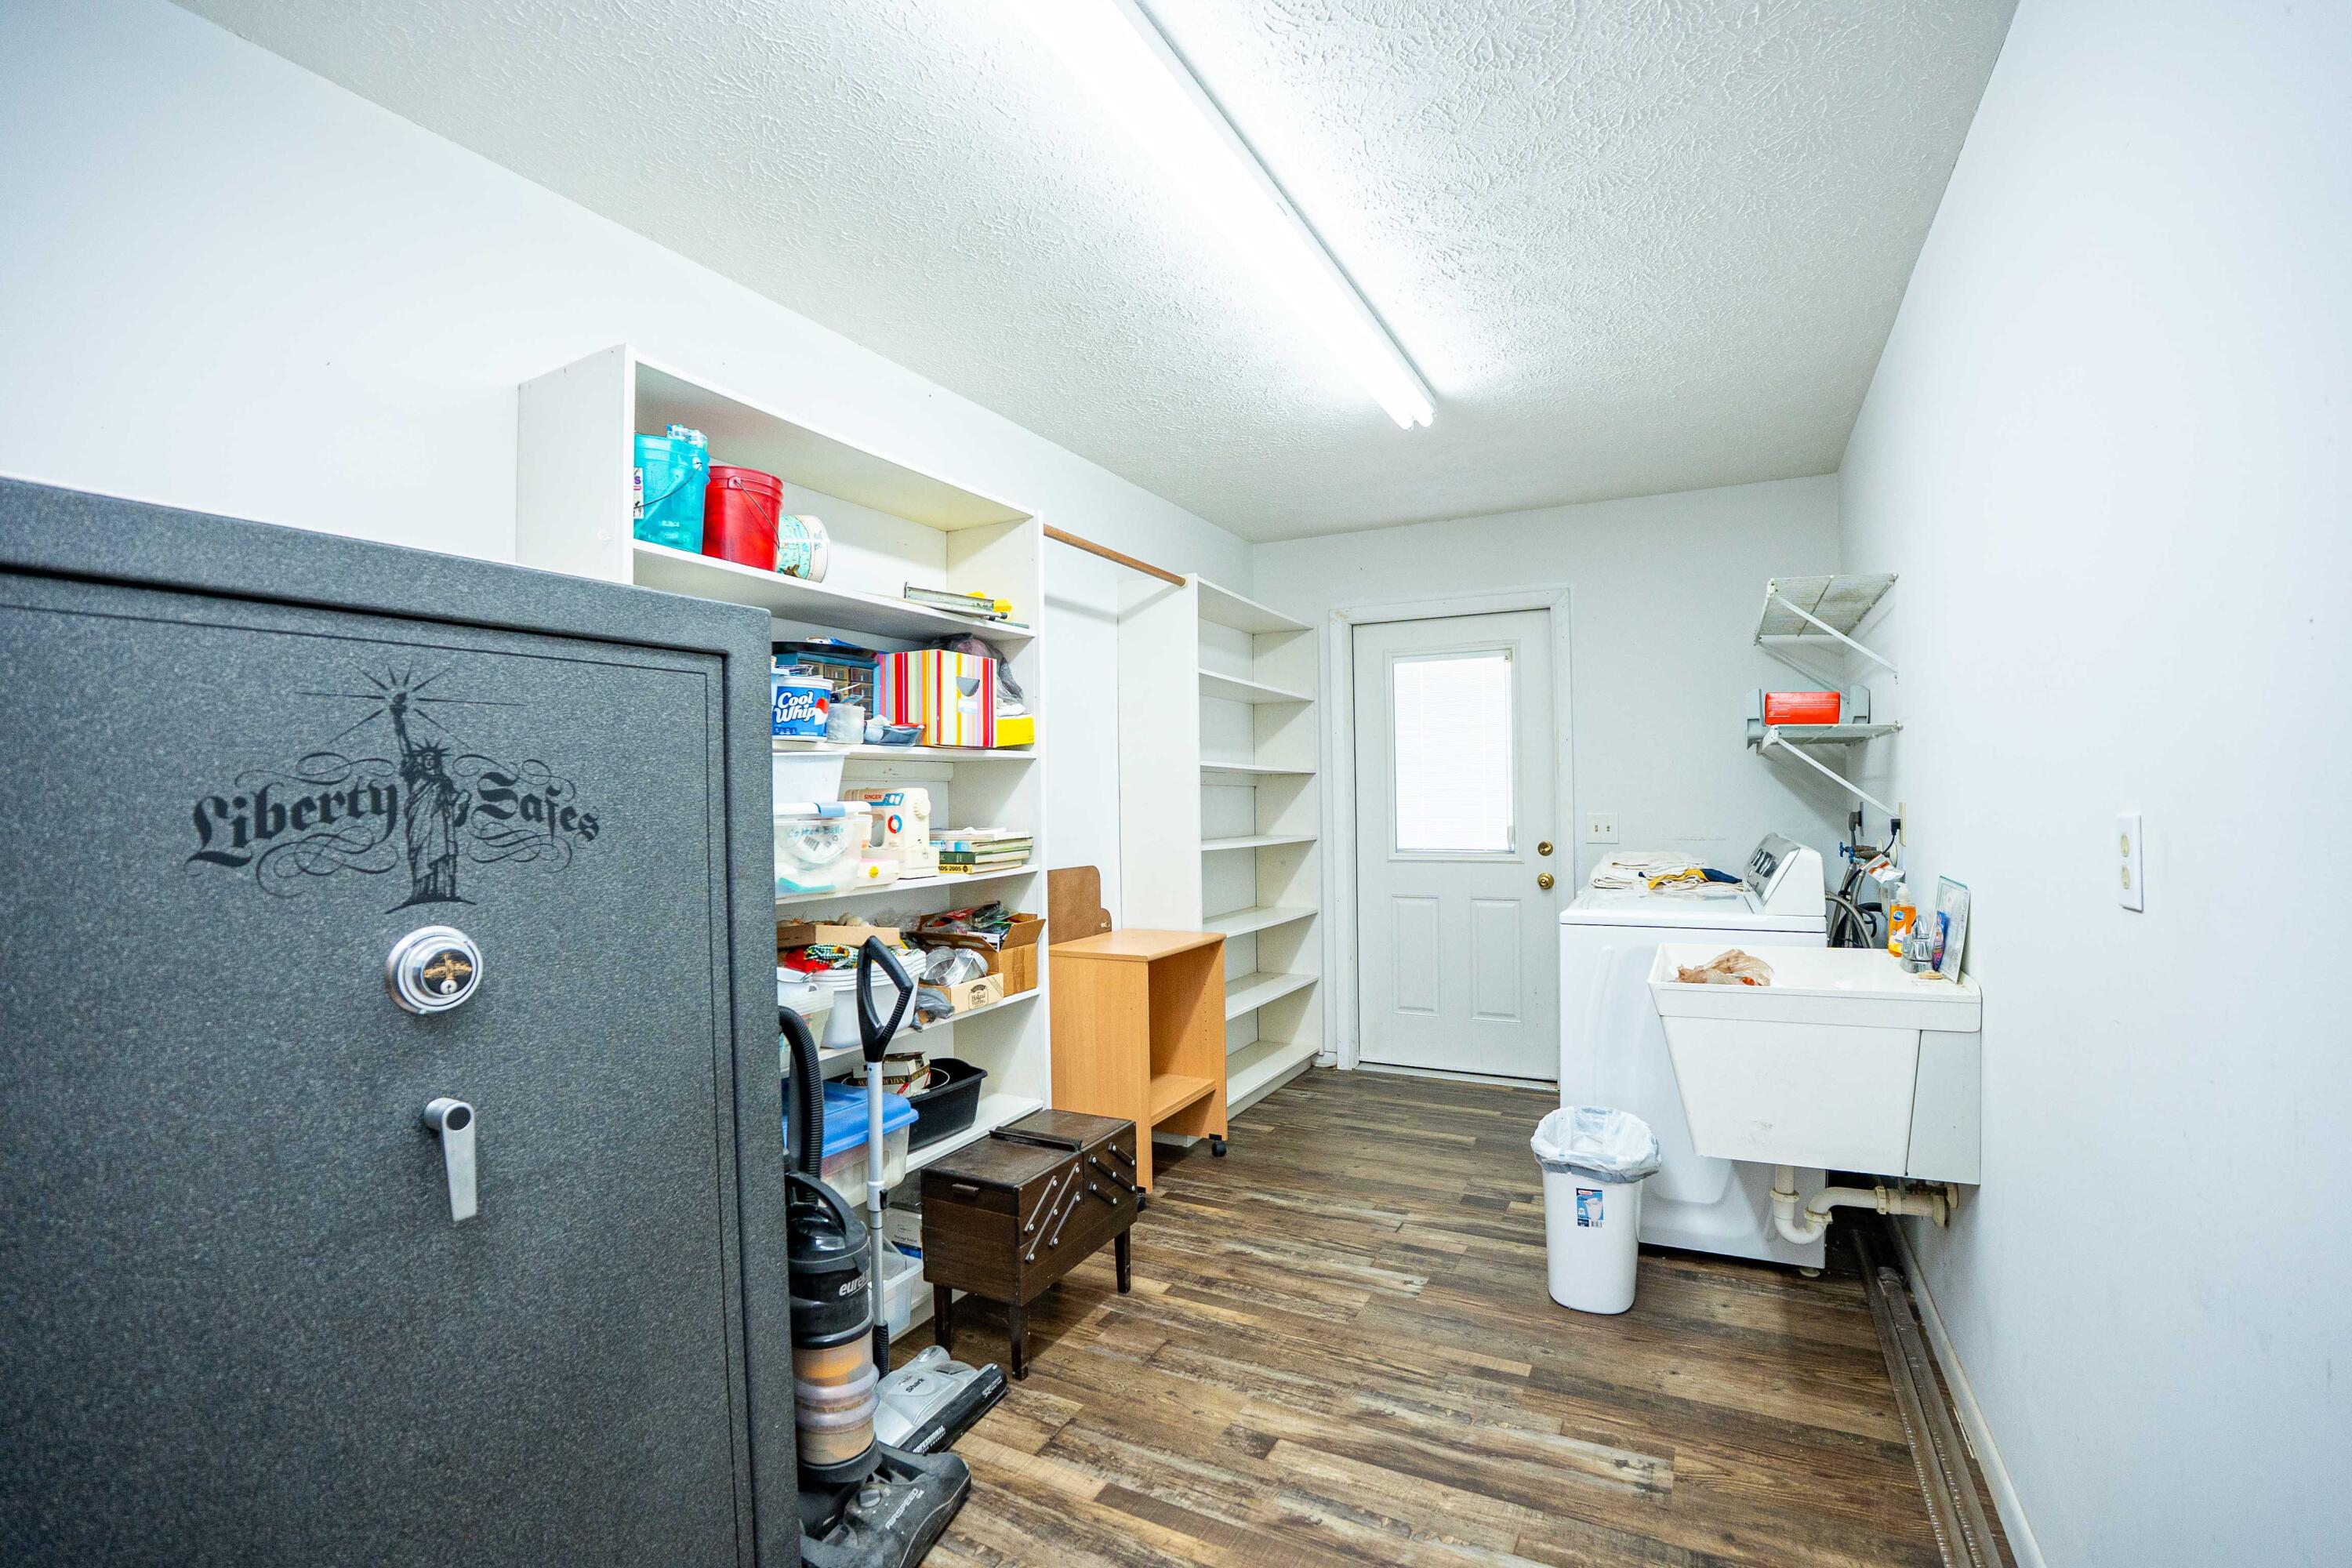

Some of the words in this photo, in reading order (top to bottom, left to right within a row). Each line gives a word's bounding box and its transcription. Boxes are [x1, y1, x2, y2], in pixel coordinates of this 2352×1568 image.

[778, 691, 814, 708] Cool
[773, 706, 816, 723] Whip
[185, 780, 397, 868] Liberty
[470, 771, 601, 847] Safes
[839, 1272, 867, 1296] eurek
[906, 1377, 925, 1393] Shark
[913, 1425, 946, 1453] ROFESSIONAL
[885, 1488, 918, 1530] AIRSPEED
